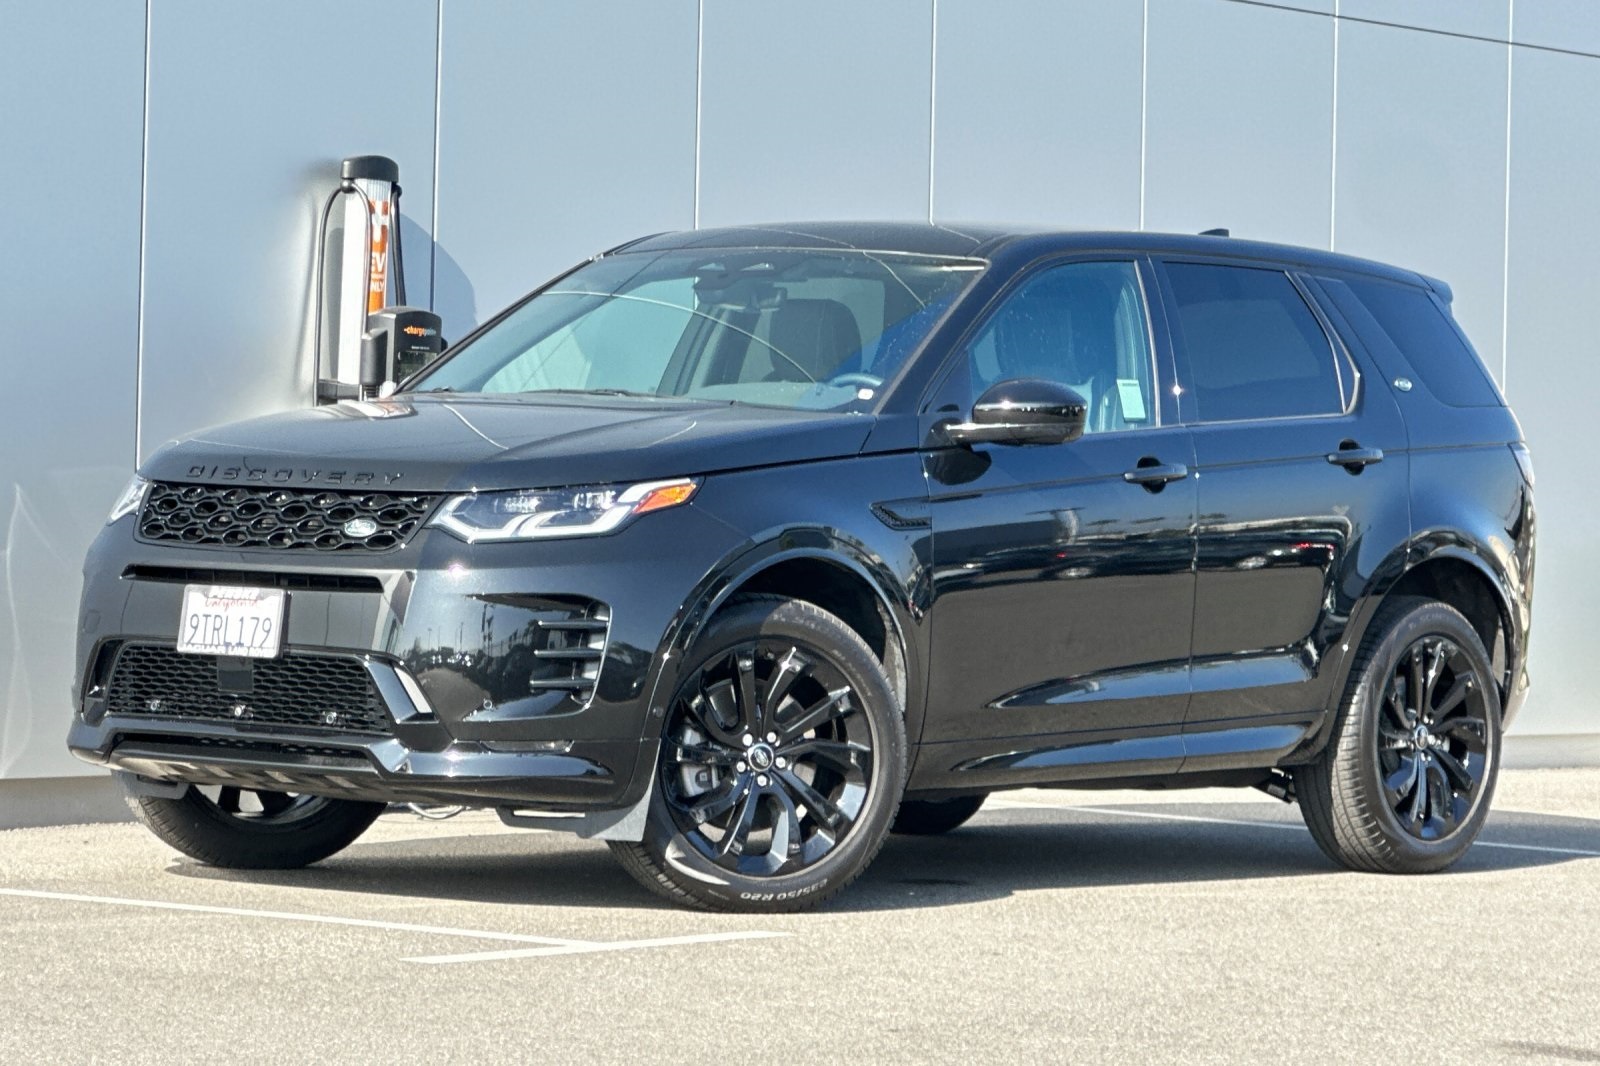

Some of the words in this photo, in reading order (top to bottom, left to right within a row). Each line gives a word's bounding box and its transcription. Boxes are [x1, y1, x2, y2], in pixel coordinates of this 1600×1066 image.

[186, 465, 404, 485] DISCOVERY
[185, 613, 273, 647] 9TRL179
[740, 891, 774, 901] R20
